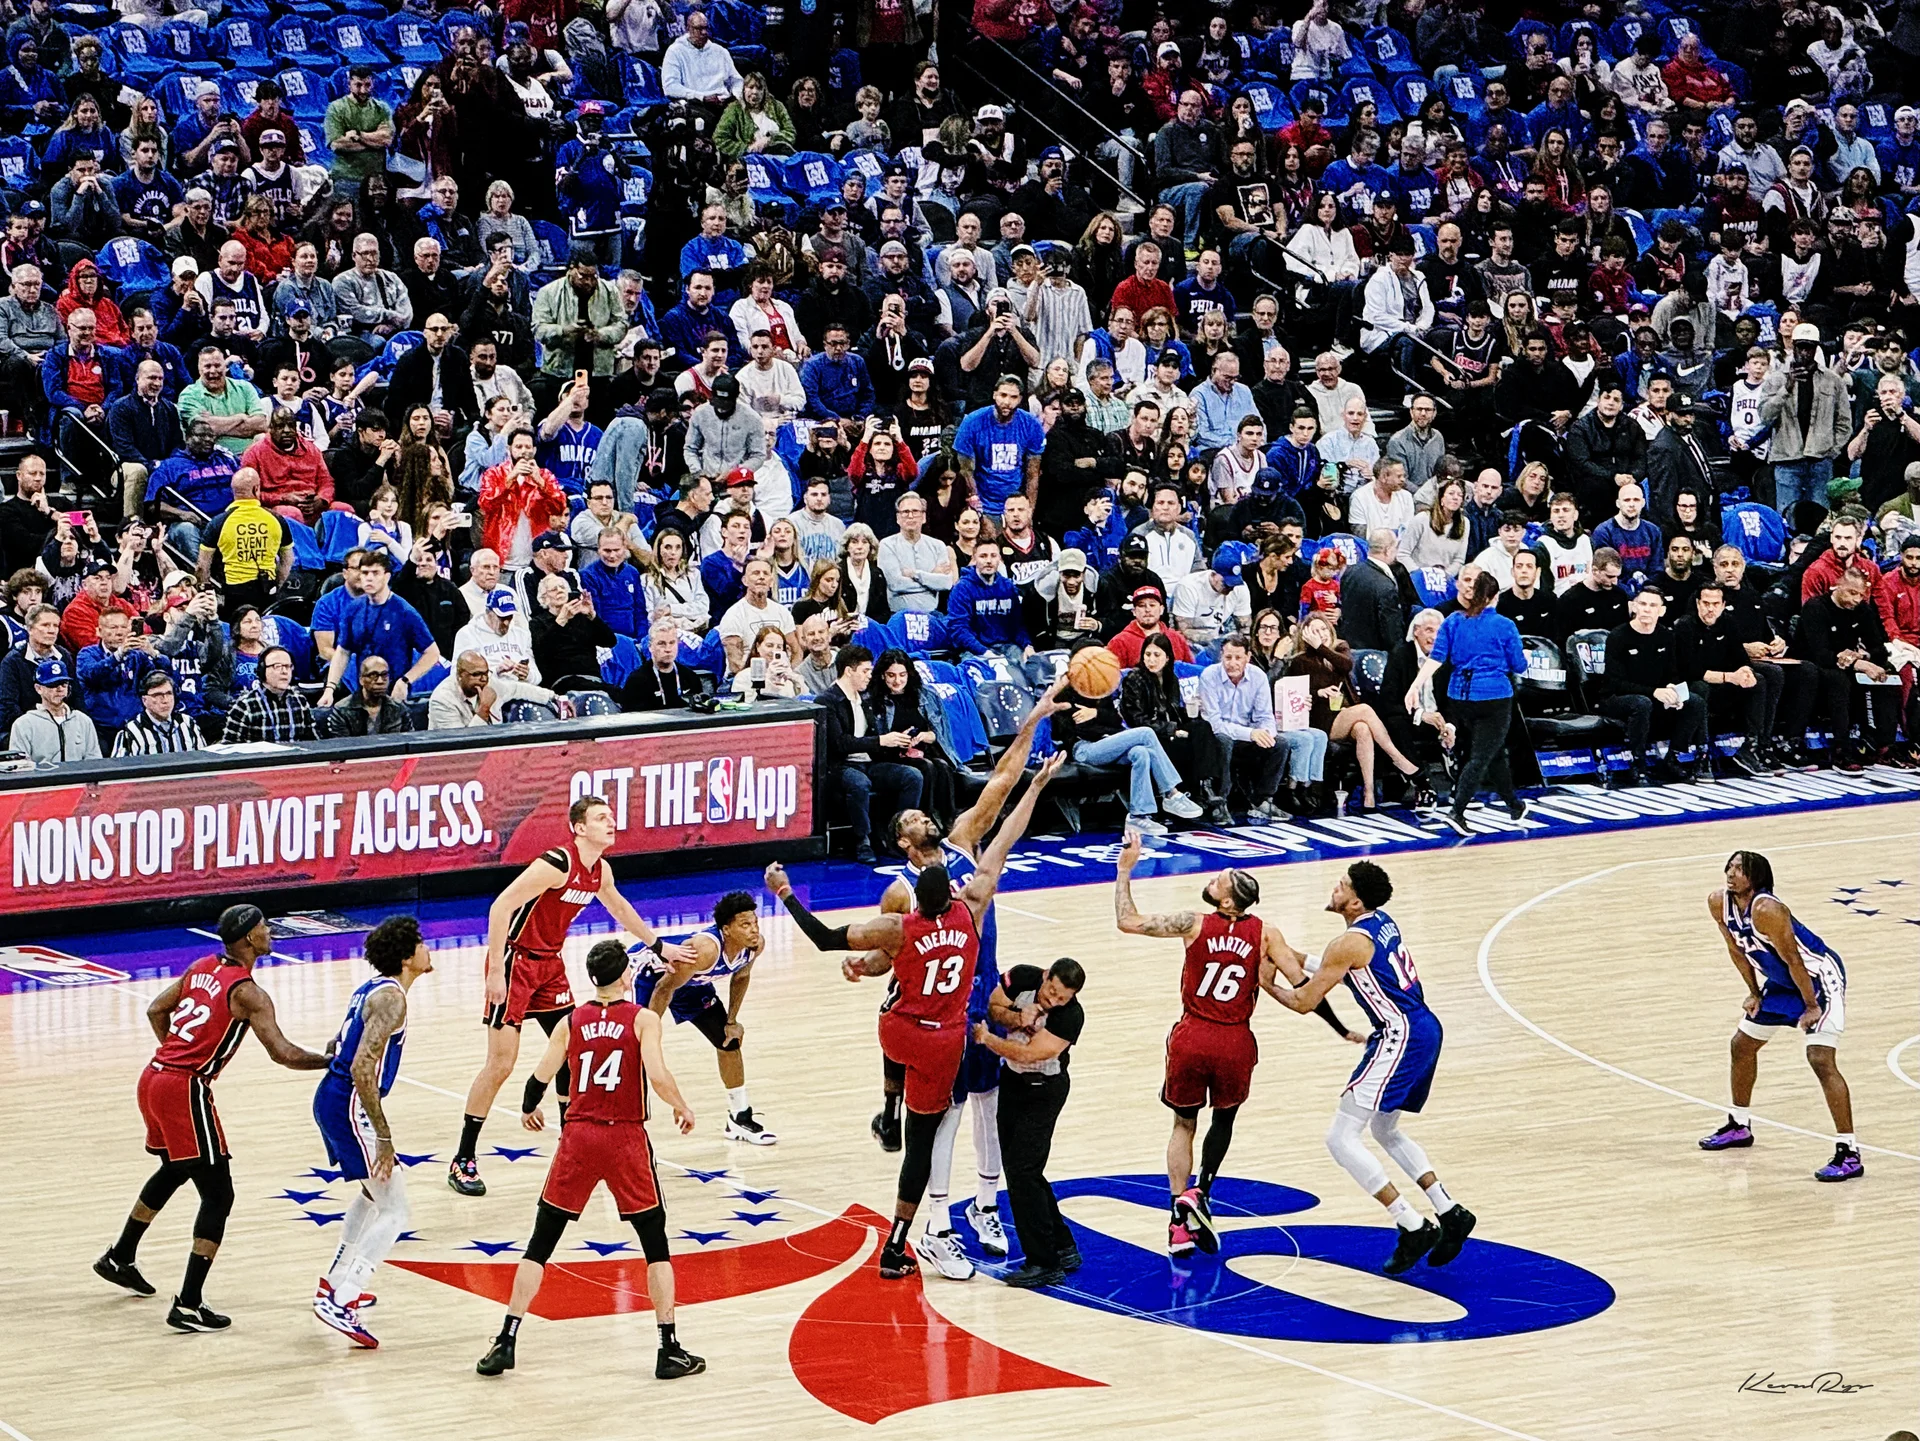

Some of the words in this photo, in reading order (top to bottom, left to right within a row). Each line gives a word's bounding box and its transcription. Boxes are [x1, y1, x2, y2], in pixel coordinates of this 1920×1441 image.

[1736, 398, 1757, 412] PHIL
[1744, 412, 1754, 425] 0
[910, 424, 941, 437] MIAMI
[992, 452, 1017, 464] LOVE
[236, 523, 268, 536] CSC
[236, 536, 268, 550] EVENT
[237, 549, 267, 562] STAFF
[778, 587, 810, 604] HIL
[906, 621, 929, 634] LOVE
[51, 663, 62, 675] 3
[641, 761, 704, 828] THE
[735, 755, 797, 830] App
[12, 807, 184, 888] NONSTOP
[194, 792, 344, 871] PLAYOFF
[350, 779, 493, 856] ACCESS.
[914, 930, 969, 956] ADEBAYO
[1206, 935, 1254, 959] MARTIN
[922, 956, 966, 996] 13
[1388, 943, 1419, 992] 12
[189, 973, 221, 1000] BUTLER
[1195, 962, 1247, 1002] 16
[168, 996, 211, 1042] 22
[580, 1021, 625, 1043] HERRO
[577, 1048, 624, 1093] 14
